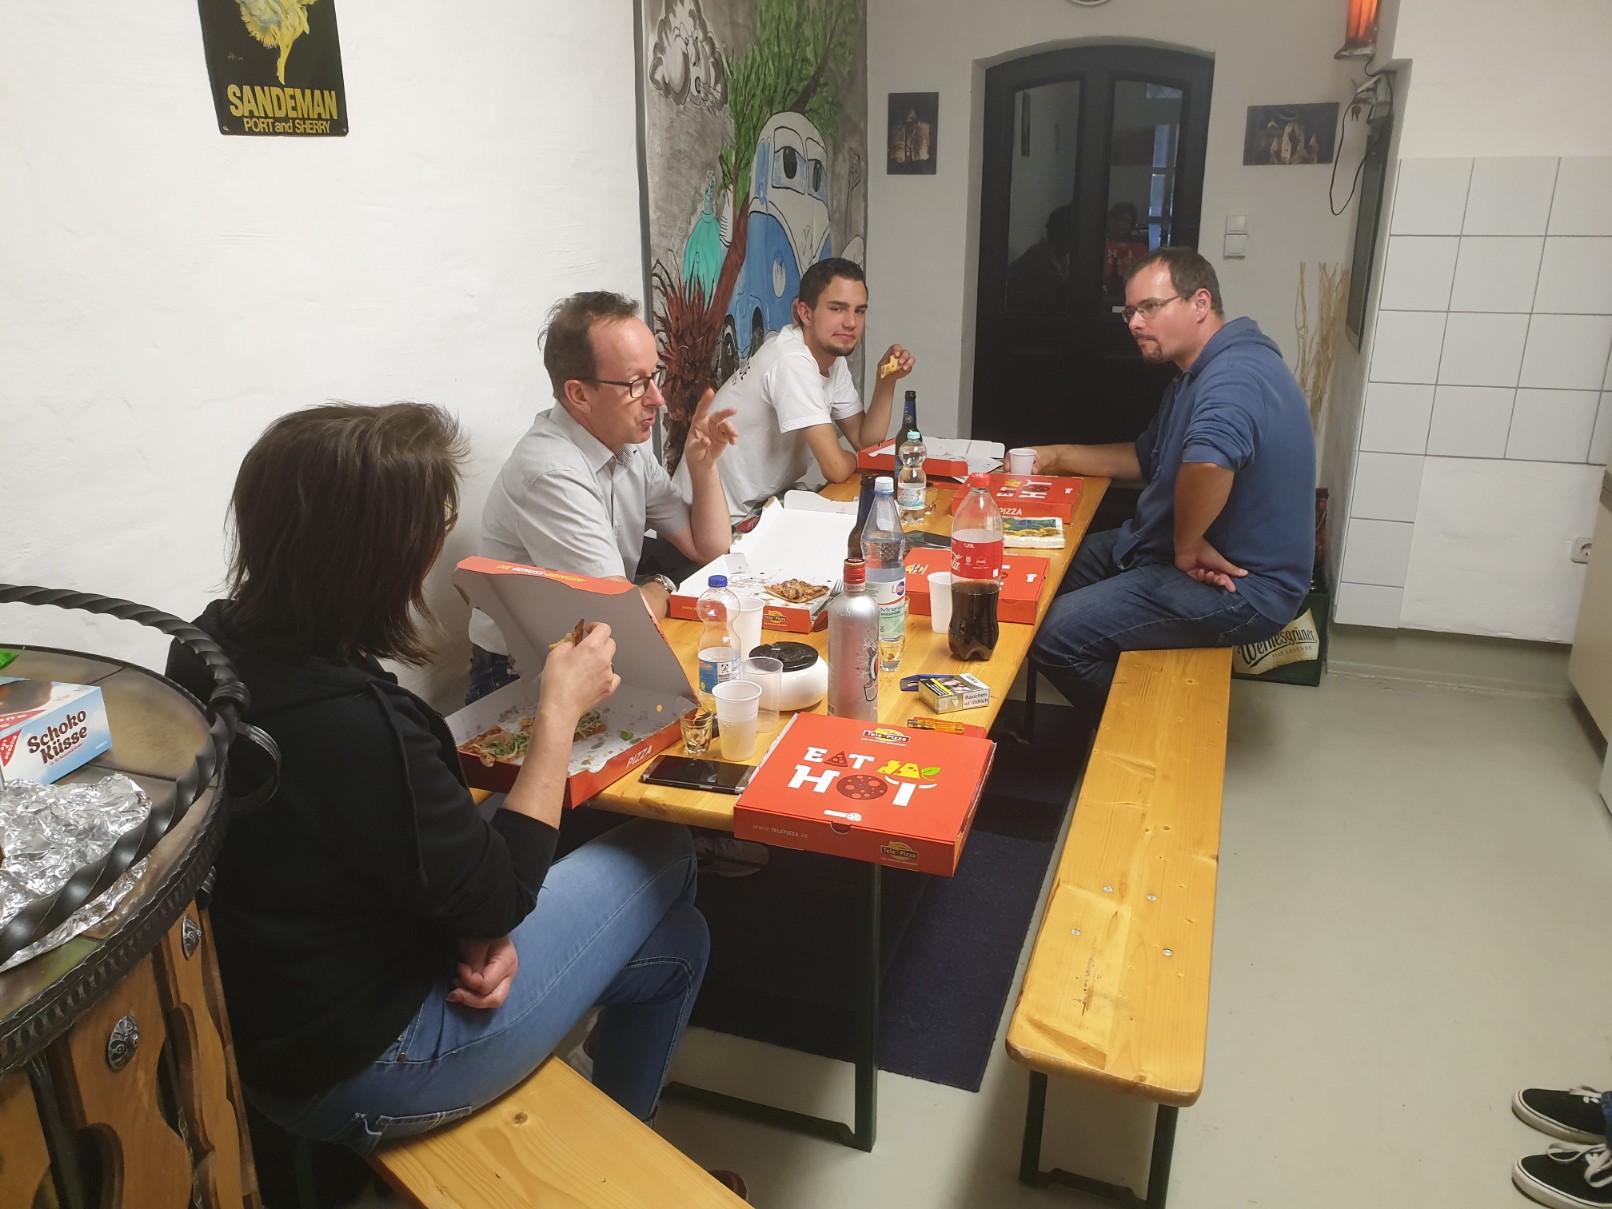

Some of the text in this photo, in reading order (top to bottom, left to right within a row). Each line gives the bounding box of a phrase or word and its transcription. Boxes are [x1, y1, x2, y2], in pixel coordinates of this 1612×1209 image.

[227, 84, 338, 119] SANDEMAN
[243, 118, 331, 134] PORT and SHERRY
[999, 507, 1023, 516] PIZZA
[1237, 626, 1316, 665] Wernesgrüner
[965, 692, 988, 700] Rauchen
[971, 698, 989, 706] tödlich
[27, 710, 87, 754] Schoko
[0, 739, 8, 751] GUT
[4, 735, 18, 760] GÜNSTIG
[40, 726, 88, 764] Küsse
[626, 745, 653, 769] PIZZA
